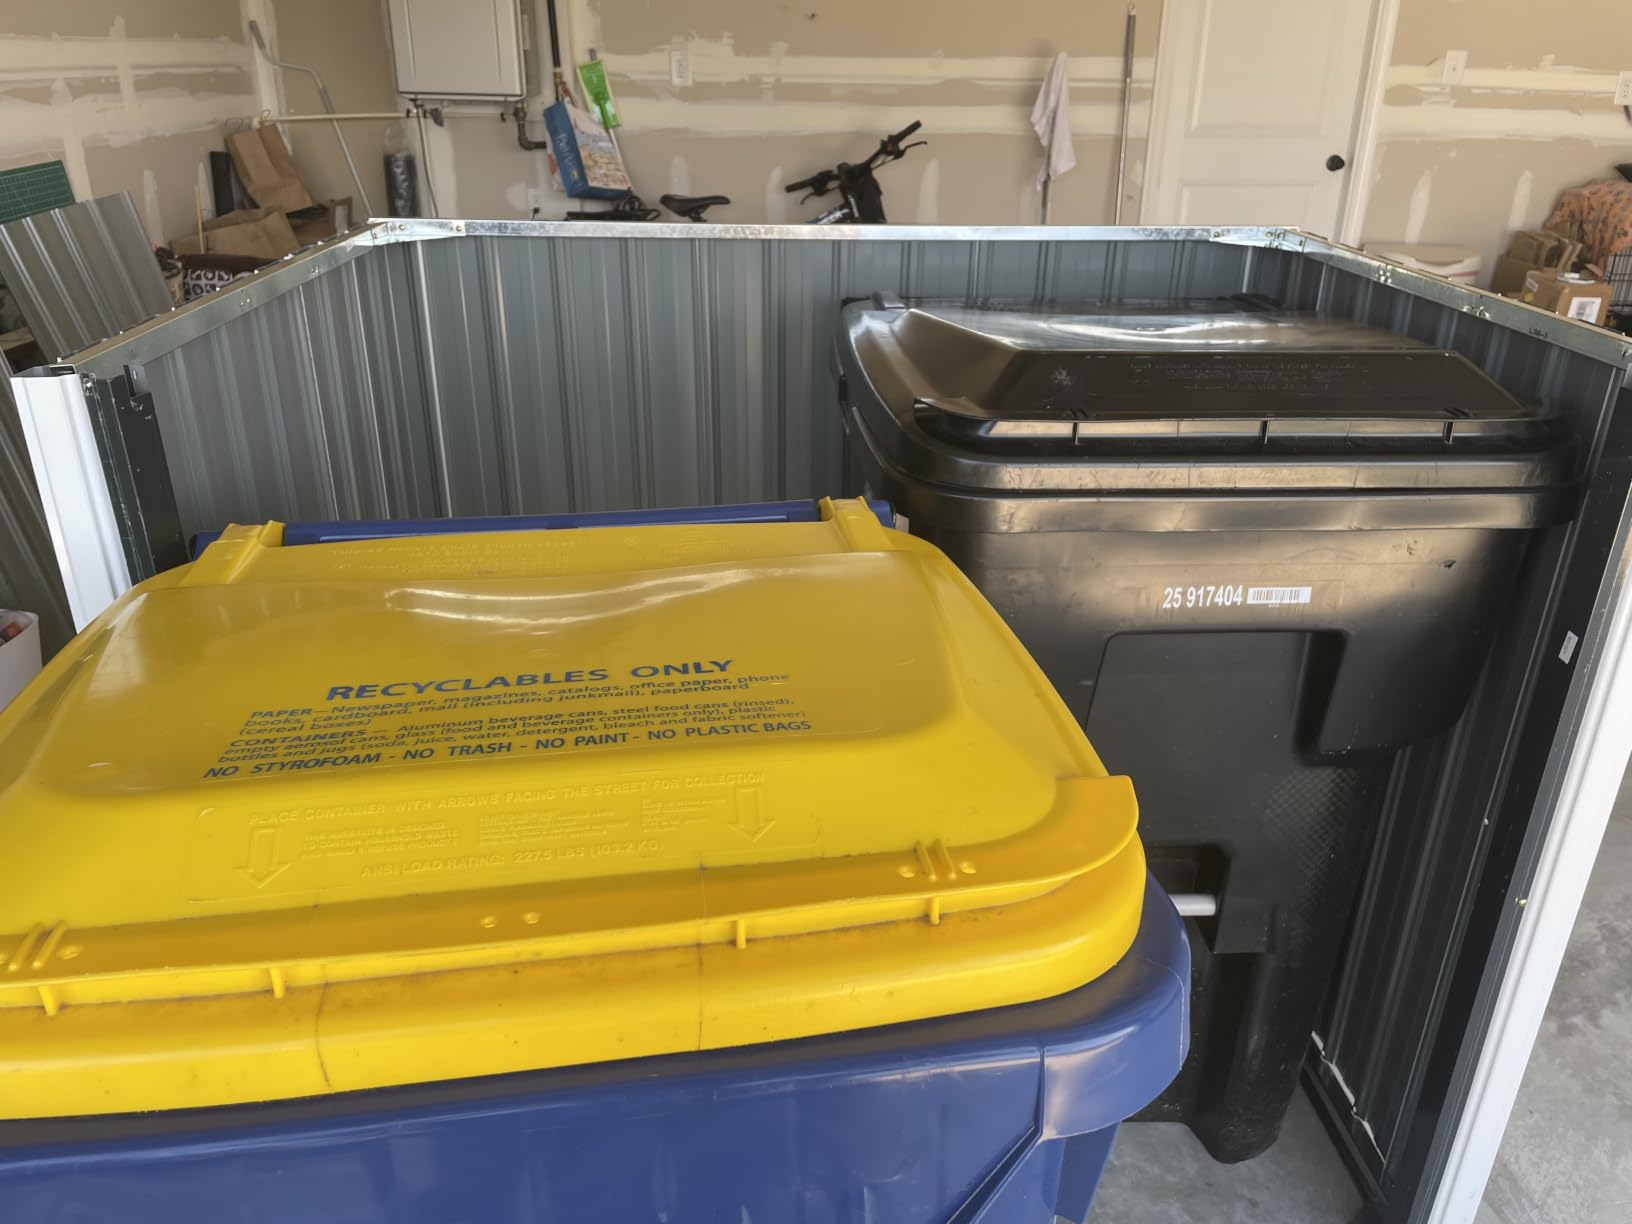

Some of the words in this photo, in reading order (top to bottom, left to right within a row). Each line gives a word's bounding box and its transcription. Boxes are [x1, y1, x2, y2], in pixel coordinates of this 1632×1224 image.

[1163, 587, 1183, 609] 25
[1186, 584, 1243, 608] 917404
[250, 708, 313, 718] PAPER
[331, 699, 437, 714] Newspaper,
[443, 691, 542, 704] magazines,
[548, 685, 624, 695] catalogs,
[630, 681, 679, 690] office
[681, 677, 733, 688] paper,
[738, 673, 790, 684] phone
[326, 668, 609, 701] RECYCLABLES
[631, 660, 732, 678] ONLY
[230, 729, 367, 747] CONTAINERS
[397, 718, 484, 732] Aluminum
[489, 712, 564, 725] beverage
[568, 709, 607, 718] cans,
[612, 706, 649, 715] steel
[654, 703, 689, 712] food
[694, 702, 729, 710] cans
[240, 725, 304, 736] (cereal
[310, 719, 372, 730] boxes)
[244, 717, 306, 727] books,
[419, 703, 457, 713] mail
[463, 695, 553, 709] (including
[651, 683, 749, 696] paperboard
[203, 766, 240, 778] NO
[249, 752, 382, 774] STYROFOAM
[403, 748, 435, 761] NO
[447, 741, 513, 757] TRASH
[535, 737, 566, 750] NO
[574, 733, 630, 747] PAINT
[647, 729, 676, 741] NO
[685, 723, 760, 737] PLASTIC
[763, 720, 811, 732] BAGS
[218, 752, 279, 763] bottles
[283, 748, 315, 757] and
[319, 744, 357, 755] jugs
[361, 739, 409, 751] (soda,
[413, 736, 457, 746] juice,
[463, 731, 510, 741] water,
[516, 725, 599, 737] detergent,
[604, 719, 655, 730] bleach
[659, 716, 688, 726] and
[692, 714, 735, 724] fabric
[224, 745, 280, 755] empty
[284, 738, 344, 748] aerosol
[350, 734, 390, 744] cans,
[396, 729, 436, 739] glass
[440, 724, 483, 736] (food
[487, 722, 517, 731] and
[522, 716, 595, 729] beverage
[599, 711, 679, 722] containers
[729, 705, 777, 715] plastic
[248, 810, 298, 825] PLACE
[305, 802, 386, 822] CONTAINER
[395, 798, 433, 814] WITH
[438, 793, 499, 809] ARROWS
[505, 789, 557, 804] FACING
[562, 785, 589, 799] THE
[594, 781, 648, 796] STREET
[653, 779, 681, 791] FOR
[685, 773, 766, 789] COLLECTION
[360, 863, 398, 879] ANSI
[402, 858, 442, 873] LOAD
[557, 847, 586, 860] LBS
